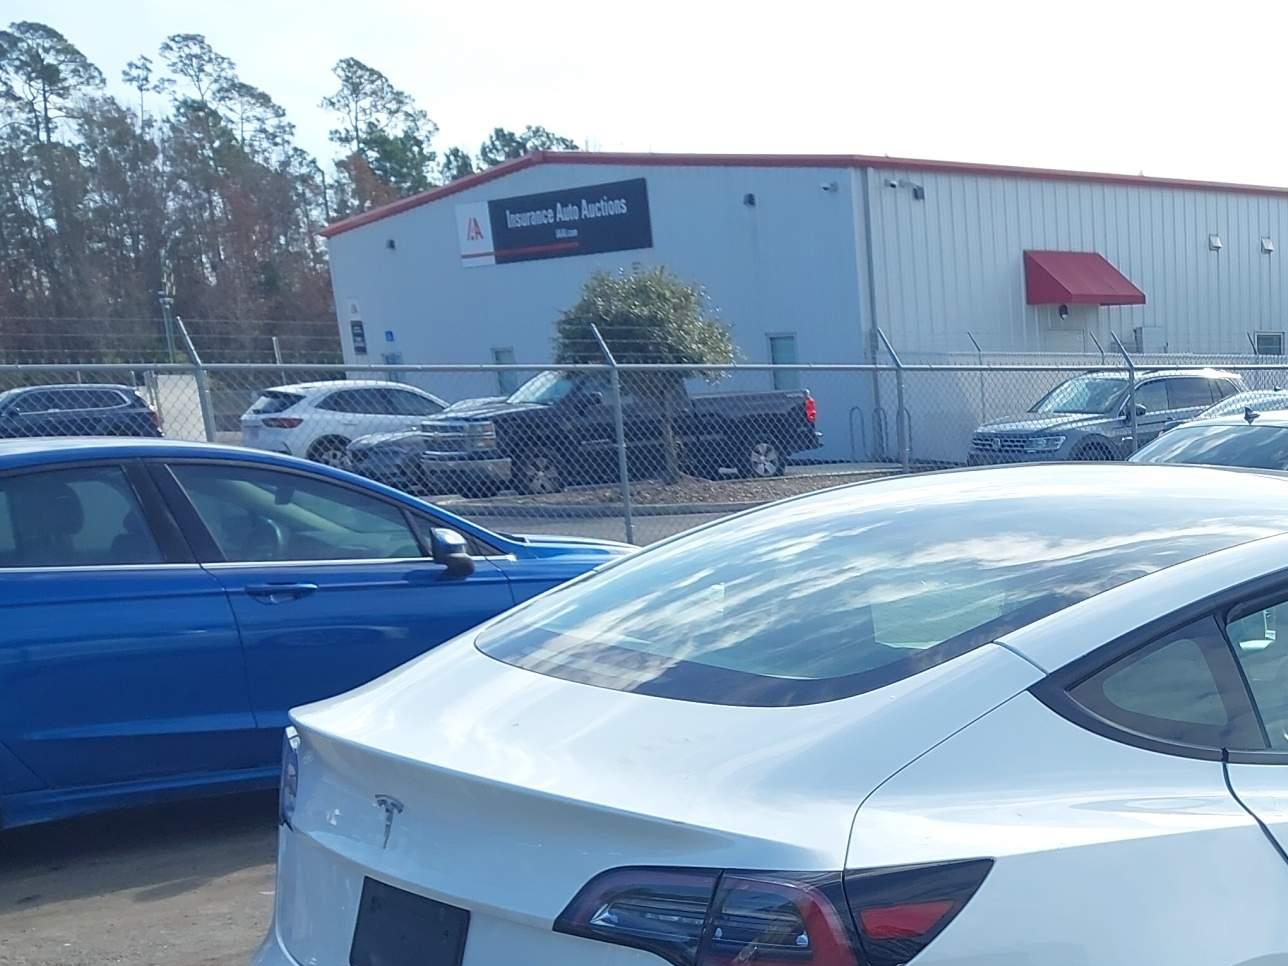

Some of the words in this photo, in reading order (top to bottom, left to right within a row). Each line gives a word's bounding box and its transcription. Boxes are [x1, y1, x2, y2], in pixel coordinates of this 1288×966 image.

[505, 209, 554, 229] Insurance
[556, 202, 579, 222] Auto
[581, 195, 628, 219] Auctions
